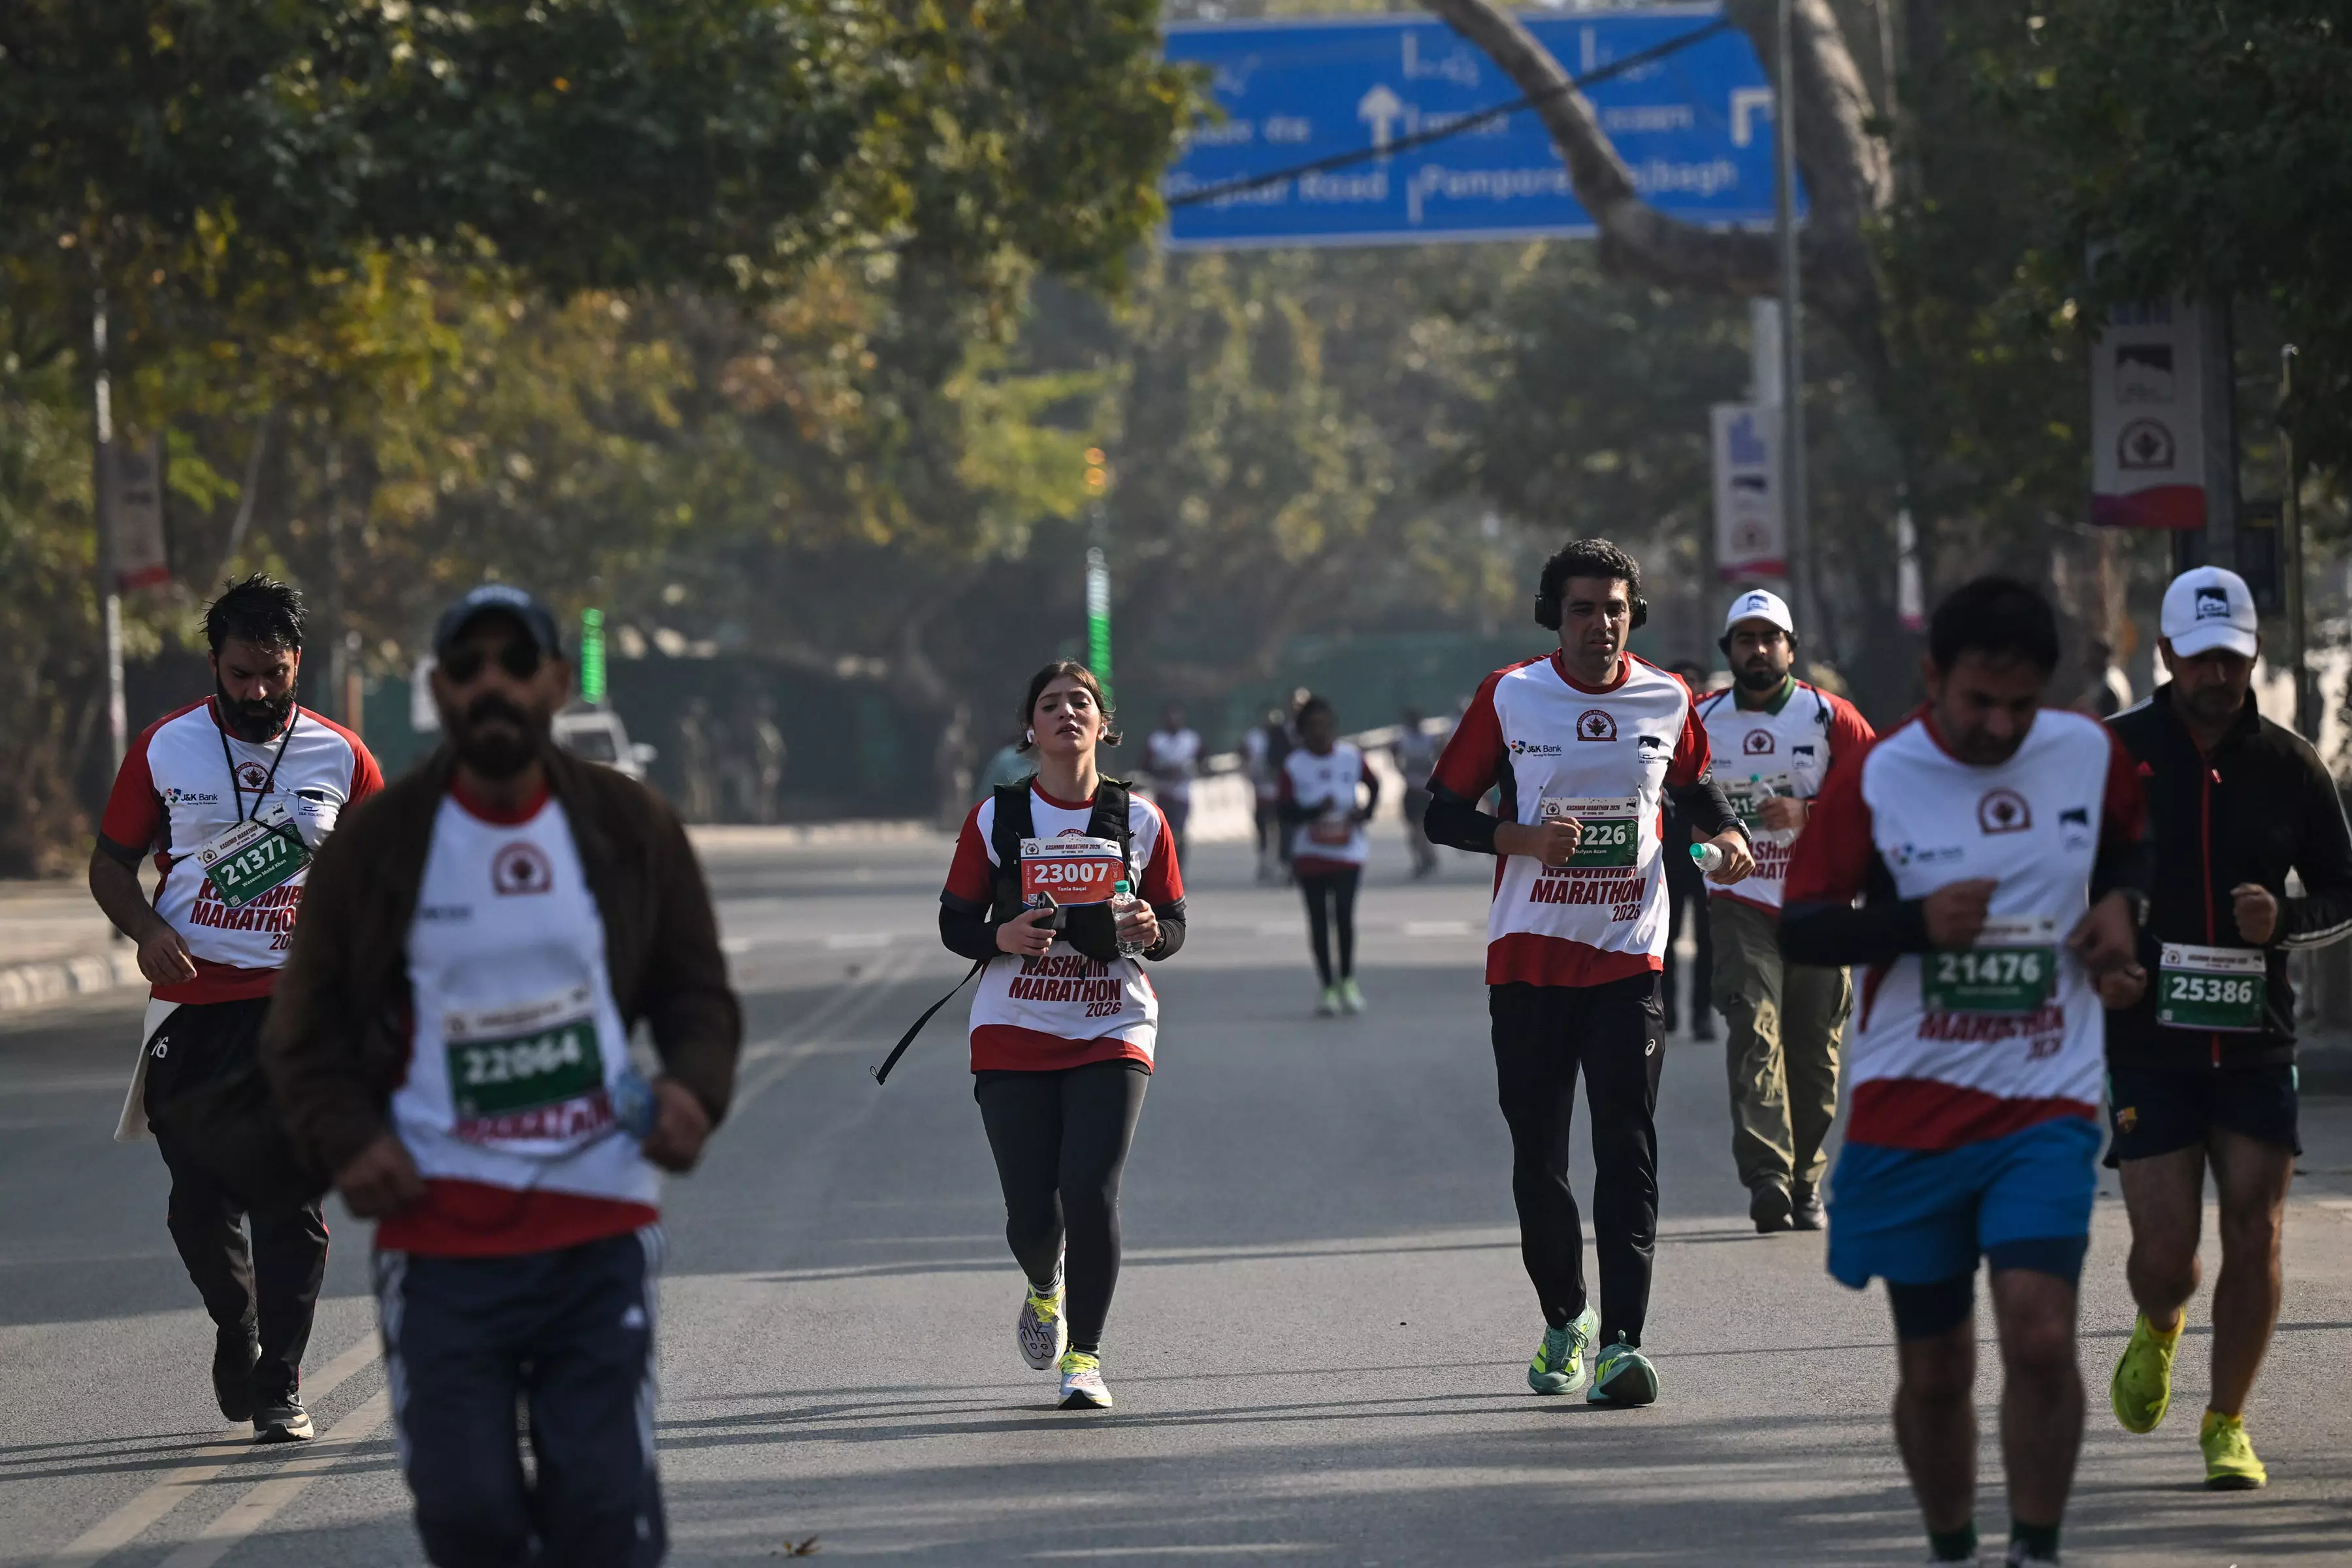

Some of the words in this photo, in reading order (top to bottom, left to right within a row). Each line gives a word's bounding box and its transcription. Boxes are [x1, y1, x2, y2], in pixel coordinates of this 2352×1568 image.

[199, 792, 218, 801] Bank
[220, 835, 237, 851] KASHMIR
[237, 823, 258, 843] MARATHON
[220, 834, 287, 887] 21377
[242, 872, 263, 887] Waseem
[262, 866, 276, 877] Mohd
[275, 858, 287, 870] Khan
[1034, 862, 1109, 883] 23007
[1529, 877, 1646, 905] MARATHON
[1612, 903, 1641, 922] 2026
[1936, 952, 2041, 983] 21476
[1008, 977, 1122, 1002] MARATHON
[2170, 975, 2253, 1004] 25386
[1085, 1002, 1122, 1018] 2026
